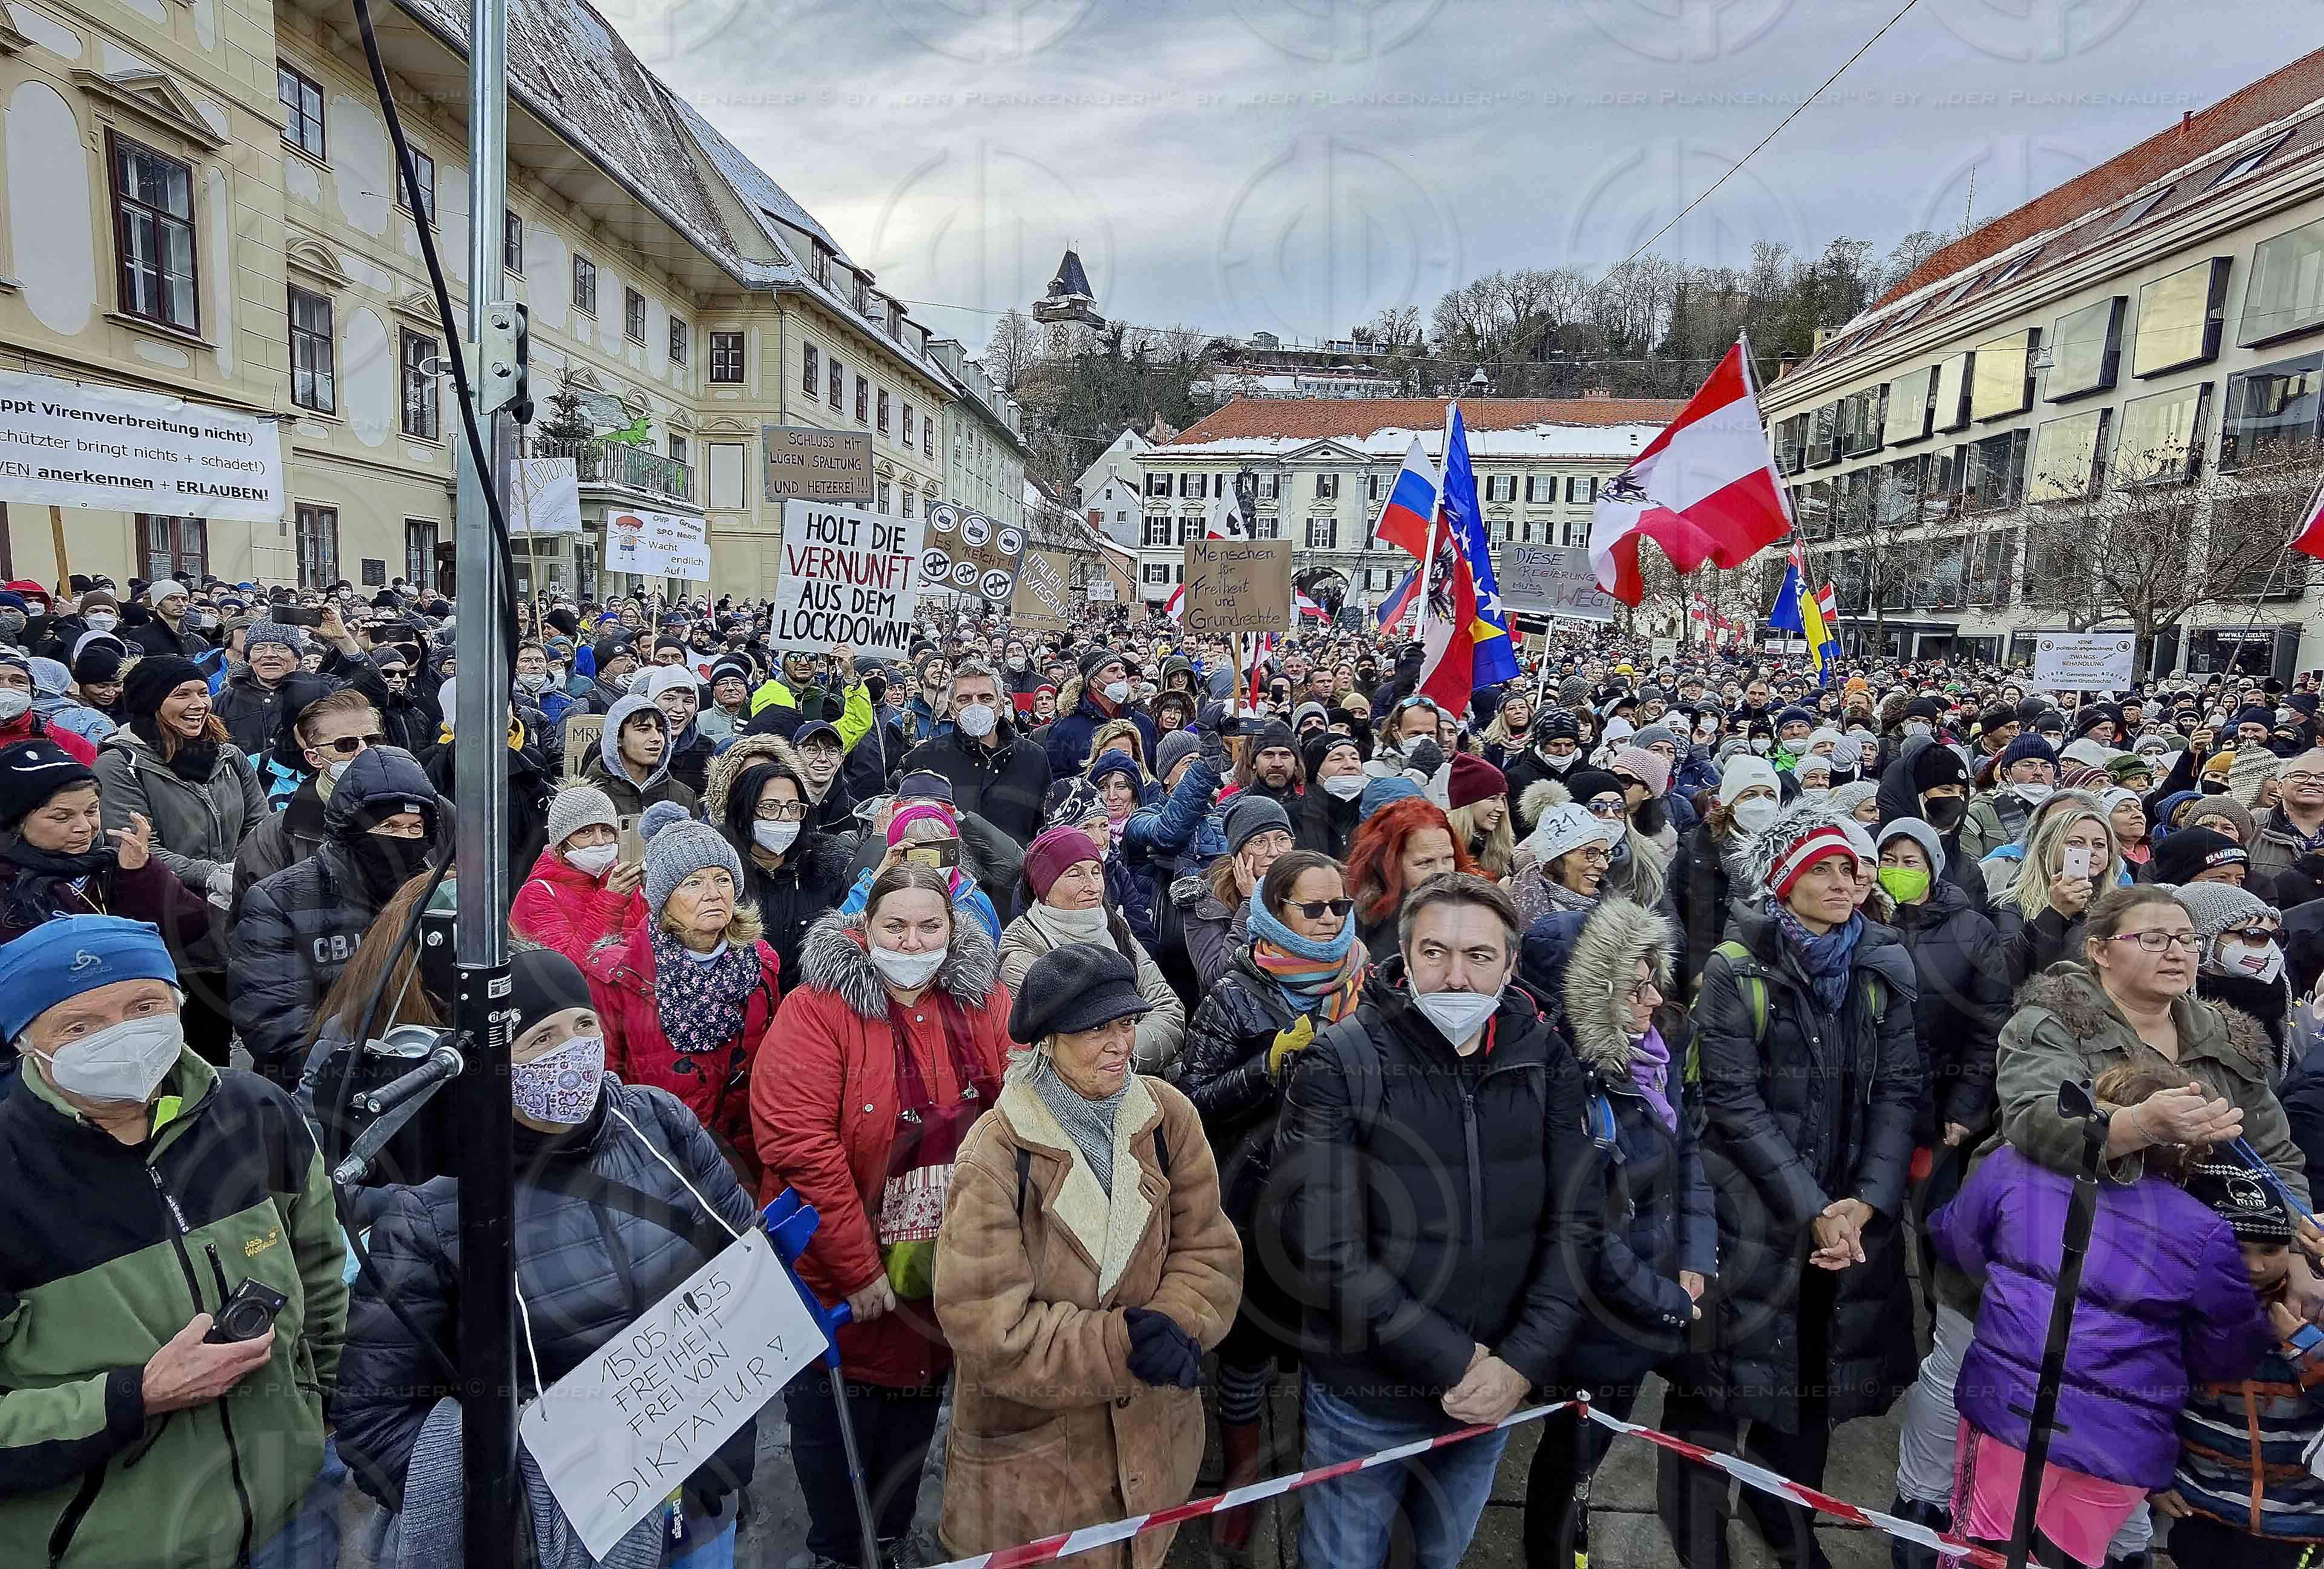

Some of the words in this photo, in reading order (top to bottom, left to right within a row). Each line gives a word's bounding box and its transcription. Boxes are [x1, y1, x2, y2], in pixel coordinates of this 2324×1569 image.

[41, 402, 199, 438] Virenverbreitung
[205, 427, 253, 446] nicht!)
[789, 432, 835, 448] SCHLUSS
[77, 438, 129, 458] bringt
[134, 447, 178, 462] nichts
[183, 454, 194, 463] +
[201, 455, 265, 475] schadet!)
[812, 455, 862, 470] SPALTUNG
[38, 467, 153, 489] anerkennen
[160, 481, 170, 489] +
[176, 480, 269, 501] ERLAUBEN!
[774, 480, 799, 493] UND
[649, 541, 678, 551] Wacht
[806, 512, 861, 547] HOLT
[872, 522, 906, 554] DIE
[665, 567, 680, 575] Auf
[671, 556, 703, 566] endlich
[787, 544, 915, 590] VERNUNFT
[1193, 543, 1273, 565] Menschen
[1028, 552, 1065, 591] ITALIEN
[1190, 574, 1250, 600] Freiheit
[798, 580, 843, 611] AUS
[851, 587, 896, 618] DEM
[1215, 594, 1235, 607] und
[779, 609, 910, 650] LOCKDOWN!
[1189, 606, 1280, 630] Grundrechte
[612, 1306, 723, 1412] FREIHEIT
[626, 1385, 684, 1437] FREI
[684, 1341, 729, 1385] VON
[607, 1356, 772, 1512] DIKTATUR
